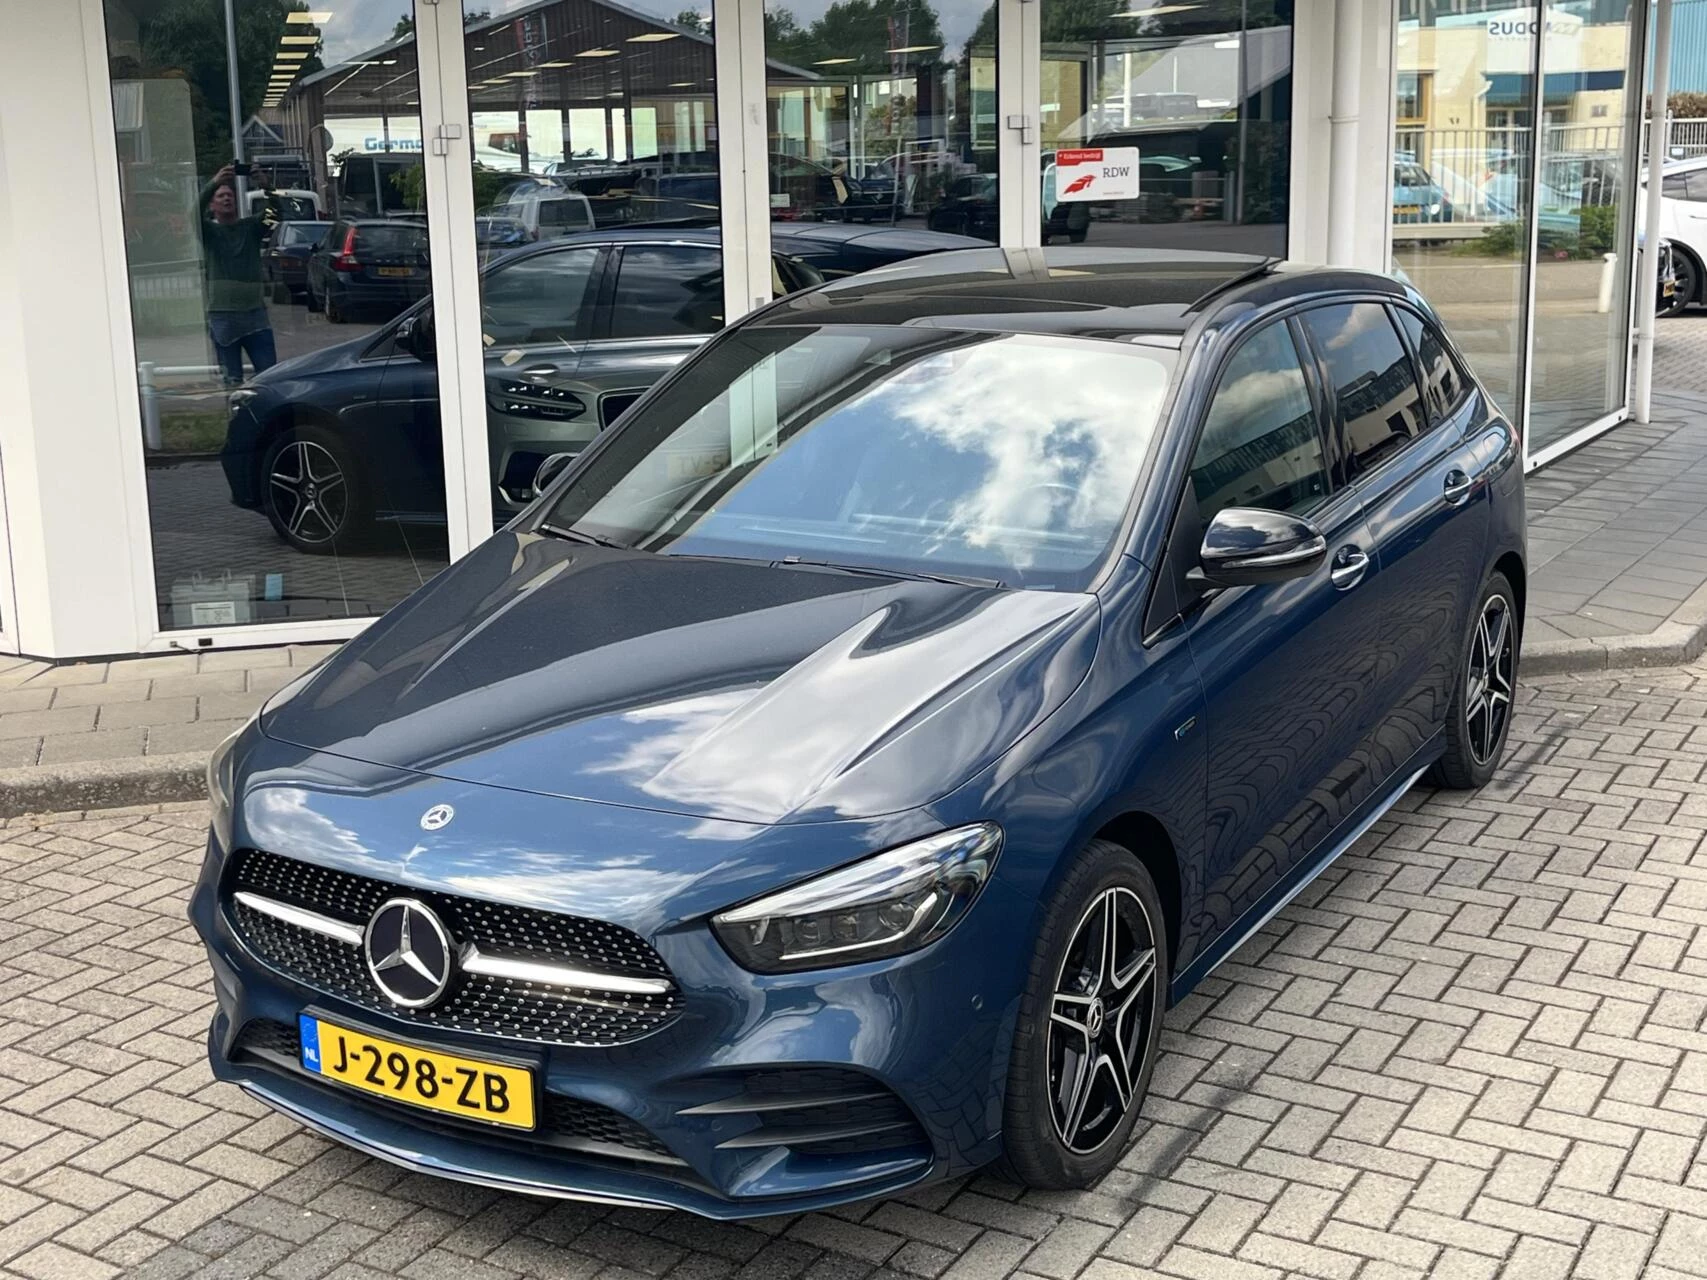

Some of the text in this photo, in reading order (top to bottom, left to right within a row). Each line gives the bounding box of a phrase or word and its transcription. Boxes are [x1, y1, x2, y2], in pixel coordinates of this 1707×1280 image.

[1103, 166, 1130, 178] RDW
[304, 1045, 319, 1063] NL
[333, 1035, 511, 1114] J-298-ZB
